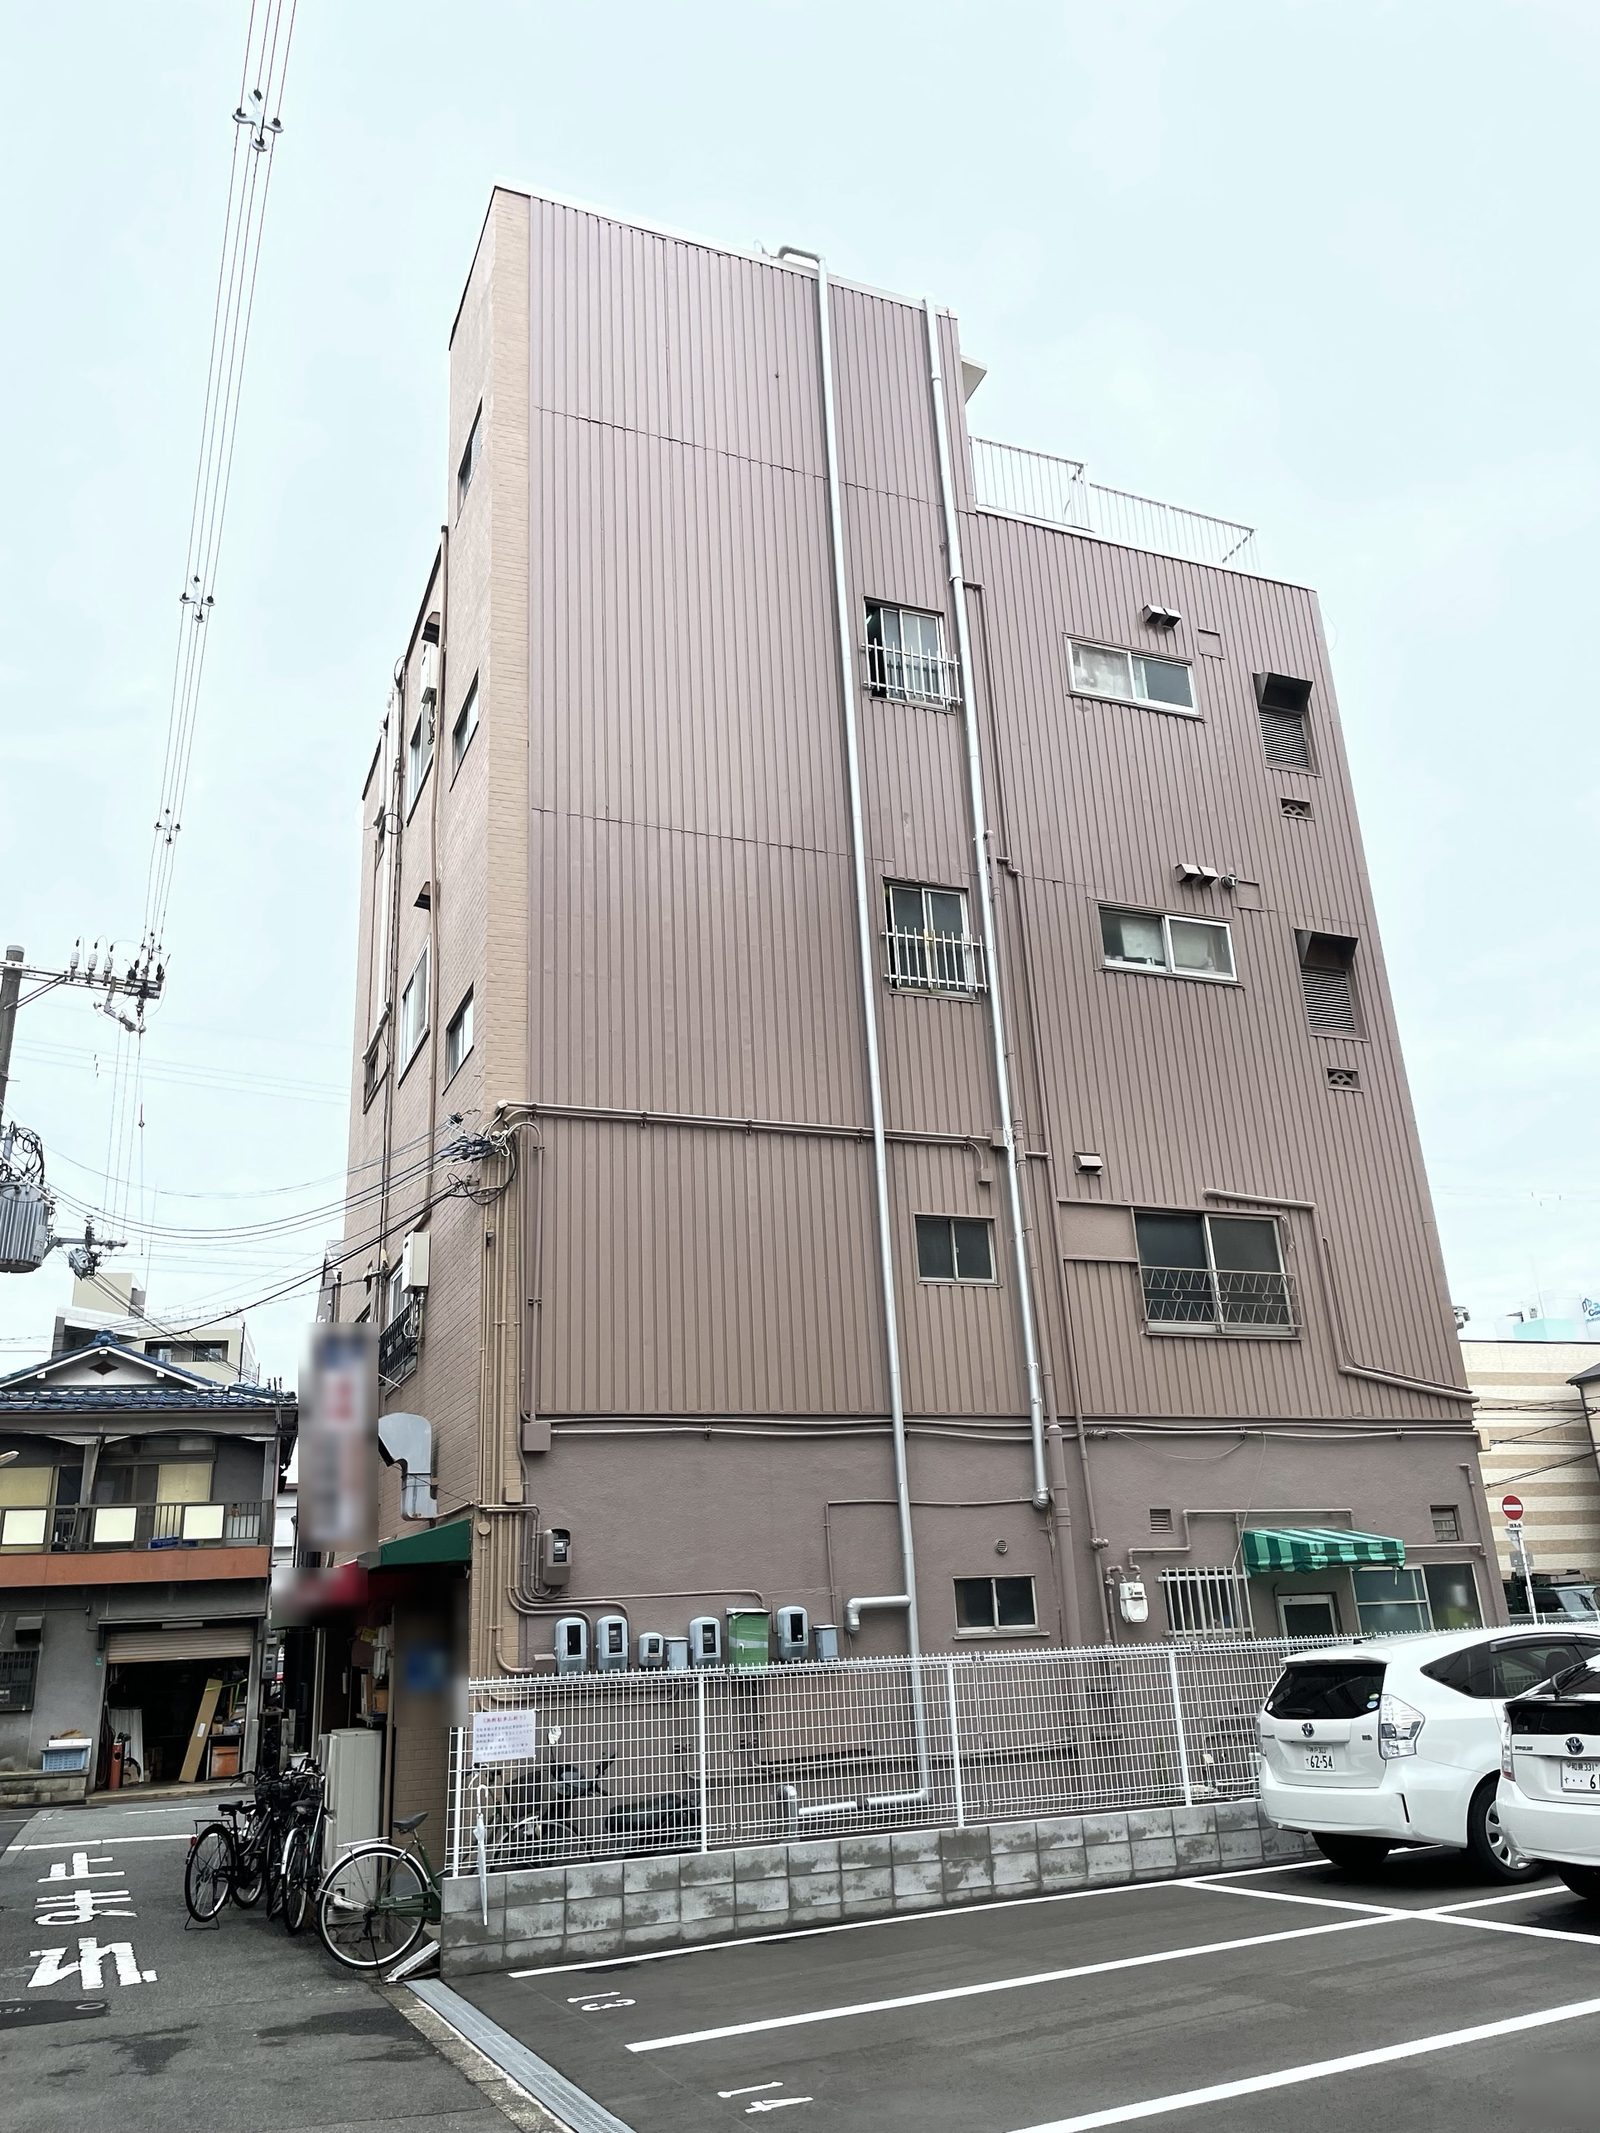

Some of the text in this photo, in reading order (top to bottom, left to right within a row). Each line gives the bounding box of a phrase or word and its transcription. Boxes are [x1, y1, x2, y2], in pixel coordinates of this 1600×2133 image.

[1310, 1755, 1333, 1768] 62-54
[27, 1852, 158, 1989] 止まれ
[567, 1991, 636, 2012] 13
[717, 2081, 814, 2114] 14
